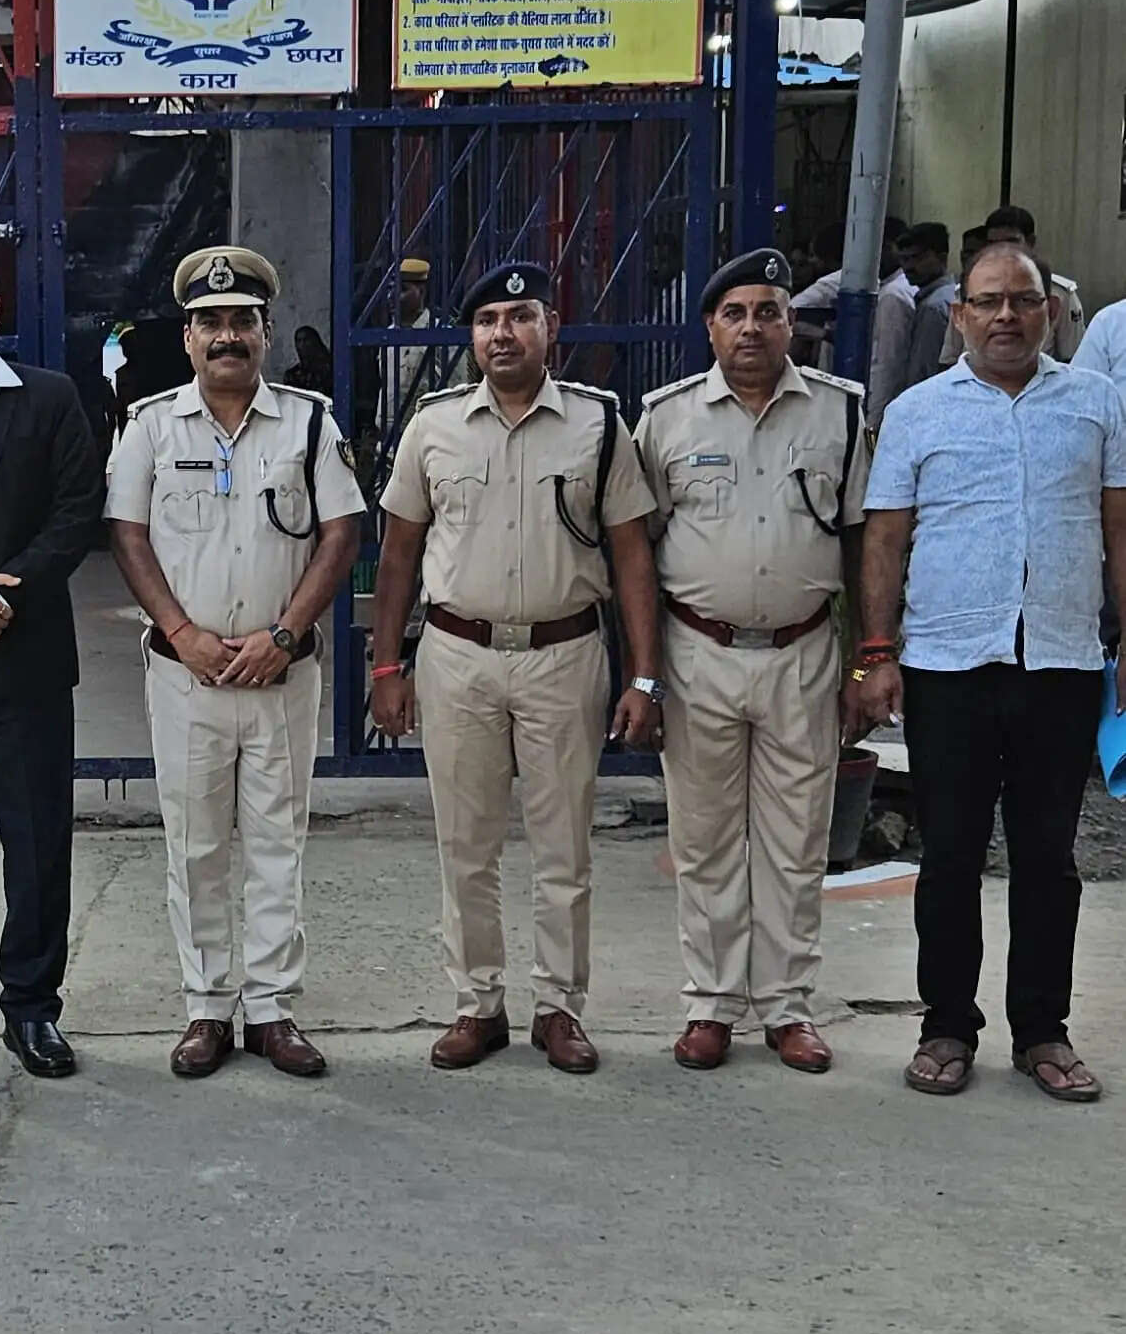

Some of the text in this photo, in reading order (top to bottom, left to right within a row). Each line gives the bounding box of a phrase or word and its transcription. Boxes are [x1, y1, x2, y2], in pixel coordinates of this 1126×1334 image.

[414, 17, 432, 27] कारा
[435, 13, 459, 27] परिसर
[507, 11, 518, 26] की
[551, 13, 571, 25] लाना
[414, 40, 432, 51] कारा
[435, 37, 459, 51] परिसर
[576, 36, 594, 48] मदद
[65, 46, 344, 66] मंडल छपरा
[179, 73, 238, 89] कारा
